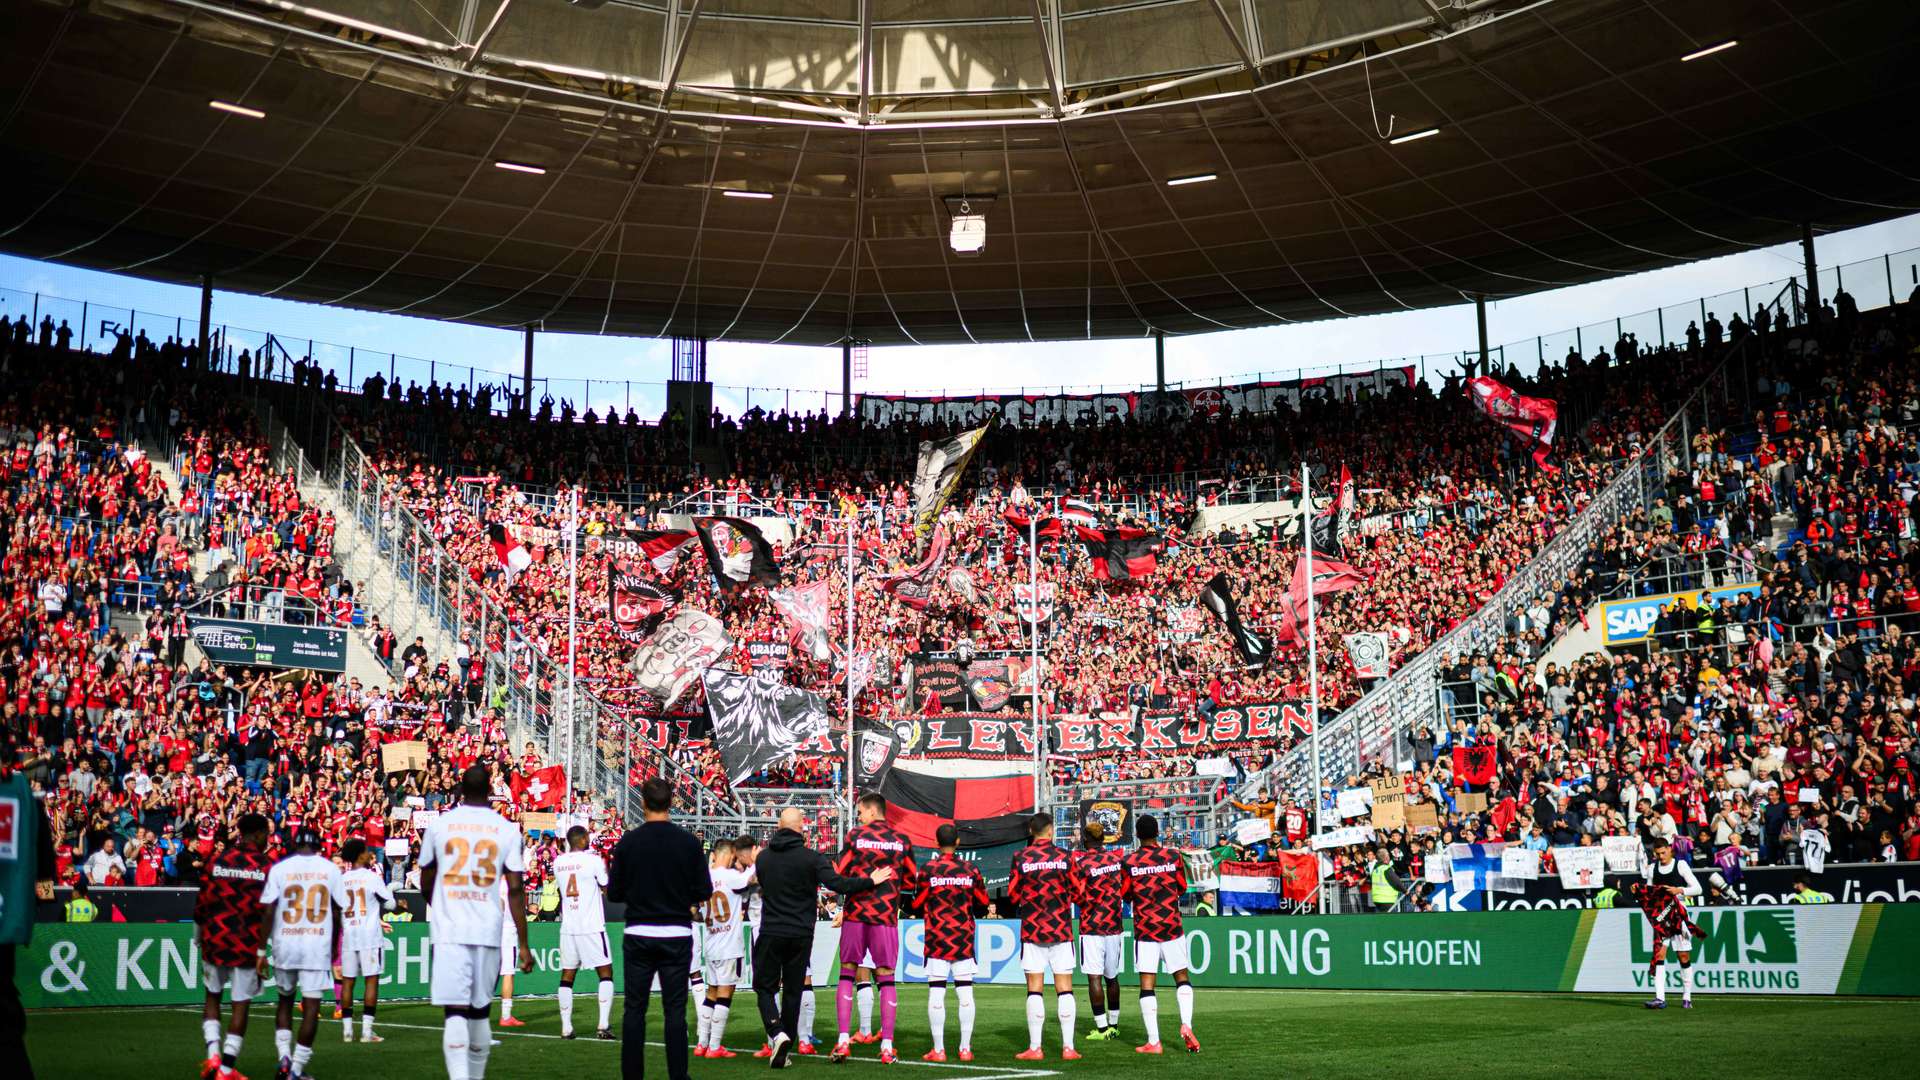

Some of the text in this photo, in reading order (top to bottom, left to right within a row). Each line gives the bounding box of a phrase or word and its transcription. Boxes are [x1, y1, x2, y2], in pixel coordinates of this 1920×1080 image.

[863, 395, 1128, 430] DEUTSCHER
[1607, 606, 1659, 635] SAP
[223, 642, 247, 650] zero
[256, 643, 275, 651] Arena
[1376, 776, 1399, 790] FLO
[1287, 815, 1302, 830] 20
[855, 838, 904, 852] Barmenia
[443, 837, 498, 888] 23
[1022, 859, 1067, 873] Barmenia
[1131, 863, 1176, 877] Barmenia
[212, 865, 266, 881] Barmenia
[987, 876, 1010, 885] Aren
[565, 873, 580, 902] 4
[282, 883, 330, 925] 30
[281, 927, 325, 936] FRIMPONG
[1228, 928, 1332, 976] RING
[1364, 939, 1482, 966] ILSHOFEN
[40, 940, 89, 993] &
[1632, 969, 1799, 989] VRSCHERUNG
